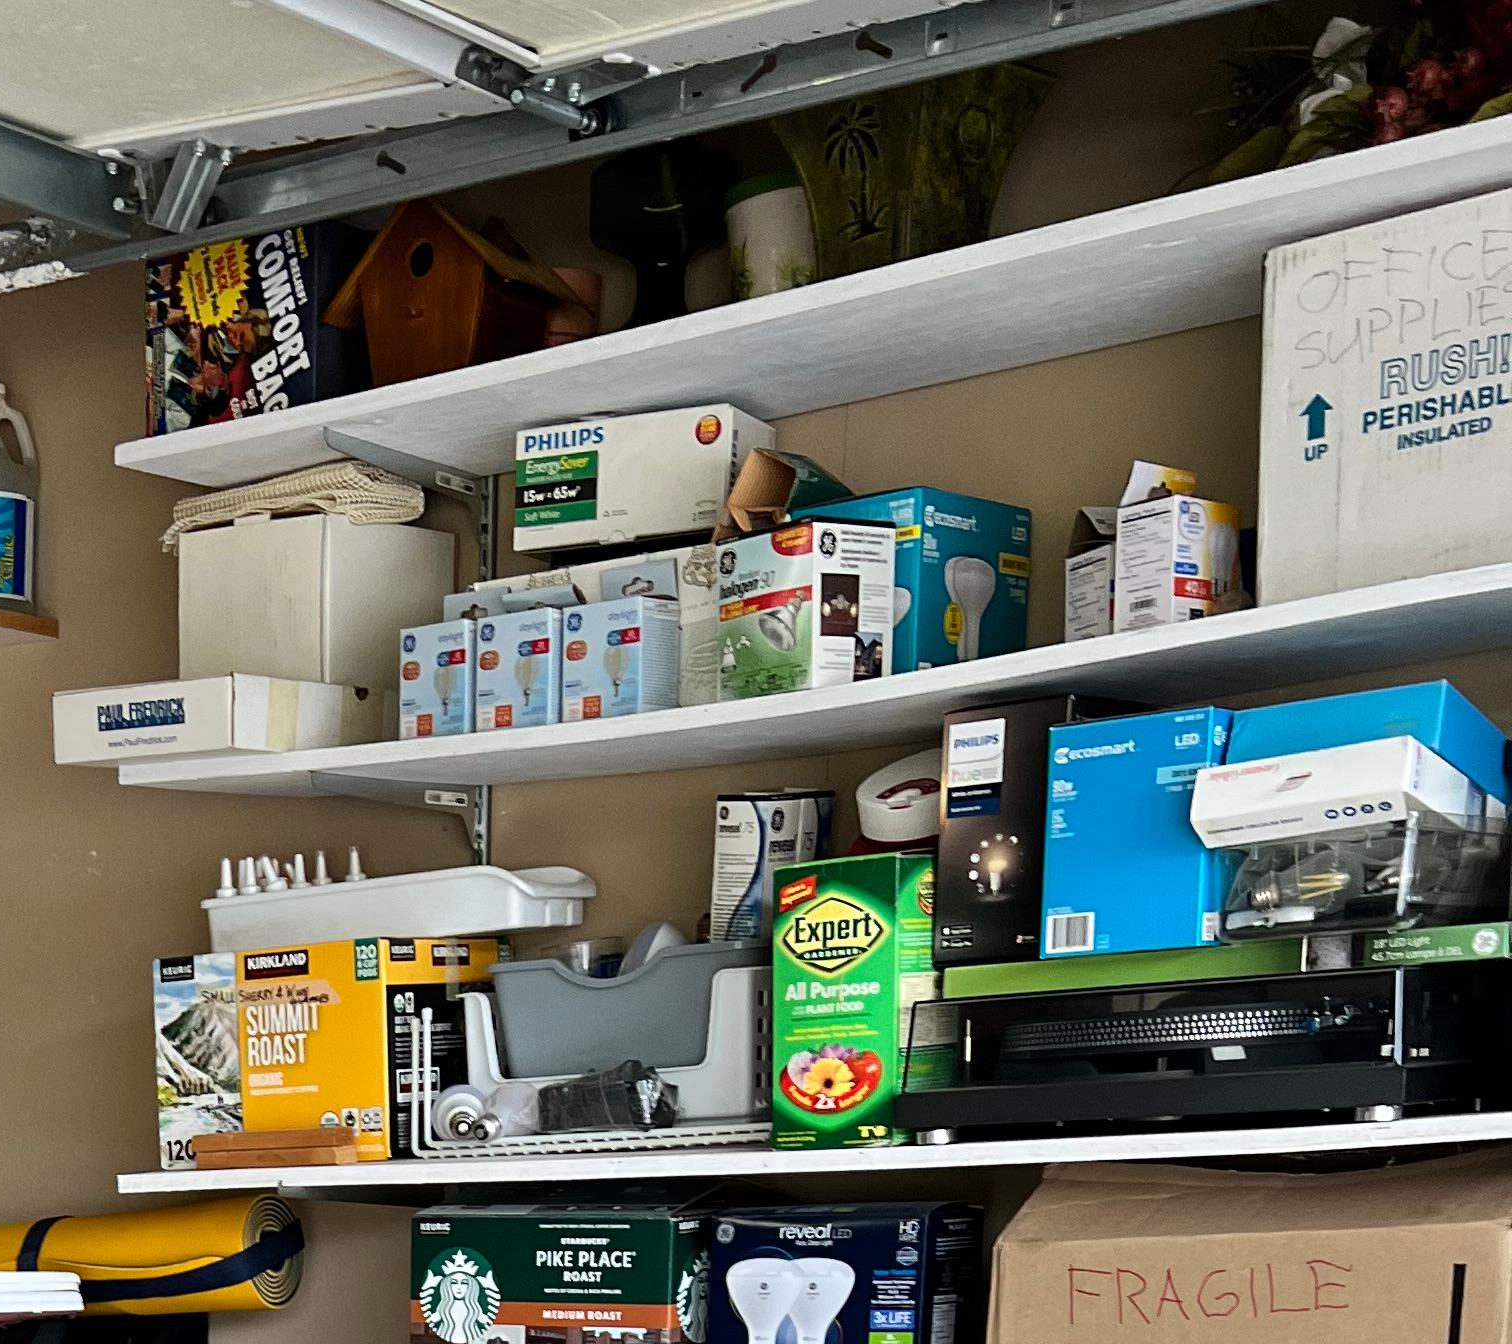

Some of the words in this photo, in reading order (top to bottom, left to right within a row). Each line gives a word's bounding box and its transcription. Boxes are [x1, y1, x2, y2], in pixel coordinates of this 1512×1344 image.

[1297, 229, 1512, 314] OFFICE
[255, 233, 312, 378] COMFORT
[1380, 333, 1512, 400] RUSH!
[1361, 383, 1512, 434] PERISHABL
[524, 427, 605, 452] PHILIPS
[1397, 416, 1493, 450] INSULATED
[1304, 443, 1329, 462] UP
[524, 456, 590, 476] EnergySaver
[720, 577, 759, 599] halogen
[97, 703, 129, 724] PAUL
[128, 697, 185, 721] FREDRICK
[953, 733, 1000, 751] PHILIPS
[1068, 739, 1136, 760] ecosmart
[951, 767, 983, 784] hue
[793, 911, 873, 950] Expert
[246, 953, 307, 971] KIRKLAND
[355, 945, 377, 960] 120
[162, 964, 193, 976] KEURIG
[201, 989, 236, 1004] SMALL
[785, 981, 807, 1001] All
[810, 978, 881, 1006] Purpose
[805, 1003, 835, 1015] PLANT
[837, 1000, 866, 1013] FOOD
[246, 1002, 320, 1037] SUMMIT
[247, 1033, 307, 1067] ROAST
[813, 1094, 837, 1110] 2x
[166, 1139, 197, 1161] 120
[779, 1223, 832, 1240] reveal
[898, 1220, 920, 1236] HD
[560, 1237, 609, 1246] STARBUCKS
[536, 1250, 573, 1268] PIKE
[577, 1251, 633, 1268] PLACE
[563, 1271, 603, 1283] ROAST
[1067, 1259, 1354, 1326] FRAGILE
[542, 1310, 586, 1320] MEDIUM
[587, 1311, 622, 1321] ROAST
[888, 1310, 912, 1324] LIFE
